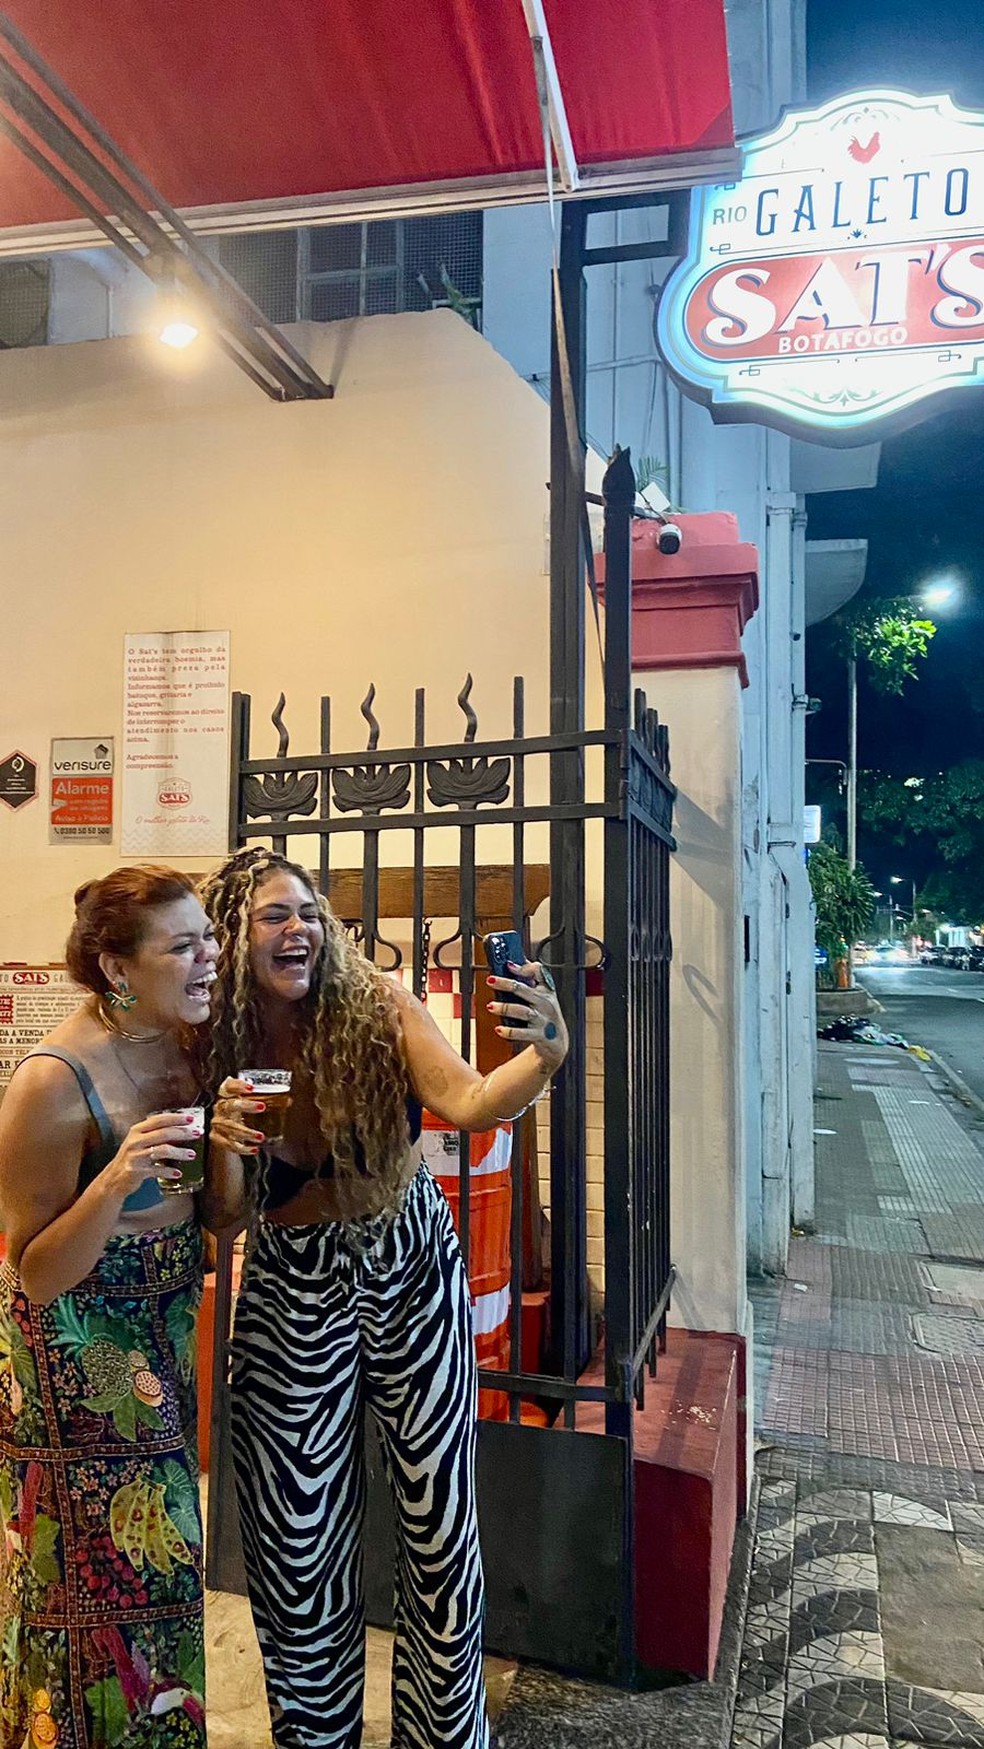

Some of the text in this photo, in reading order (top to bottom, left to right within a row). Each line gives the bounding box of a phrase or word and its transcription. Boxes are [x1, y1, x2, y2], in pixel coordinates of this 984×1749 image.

[713, 168, 969, 237] RIO GALETO
[701, 243, 984, 348] SAT'S
[778, 326, 907, 353] BOTAFOGO
[54, 760, 111, 771] verisure
[56, 780, 109, 795] Alarme
